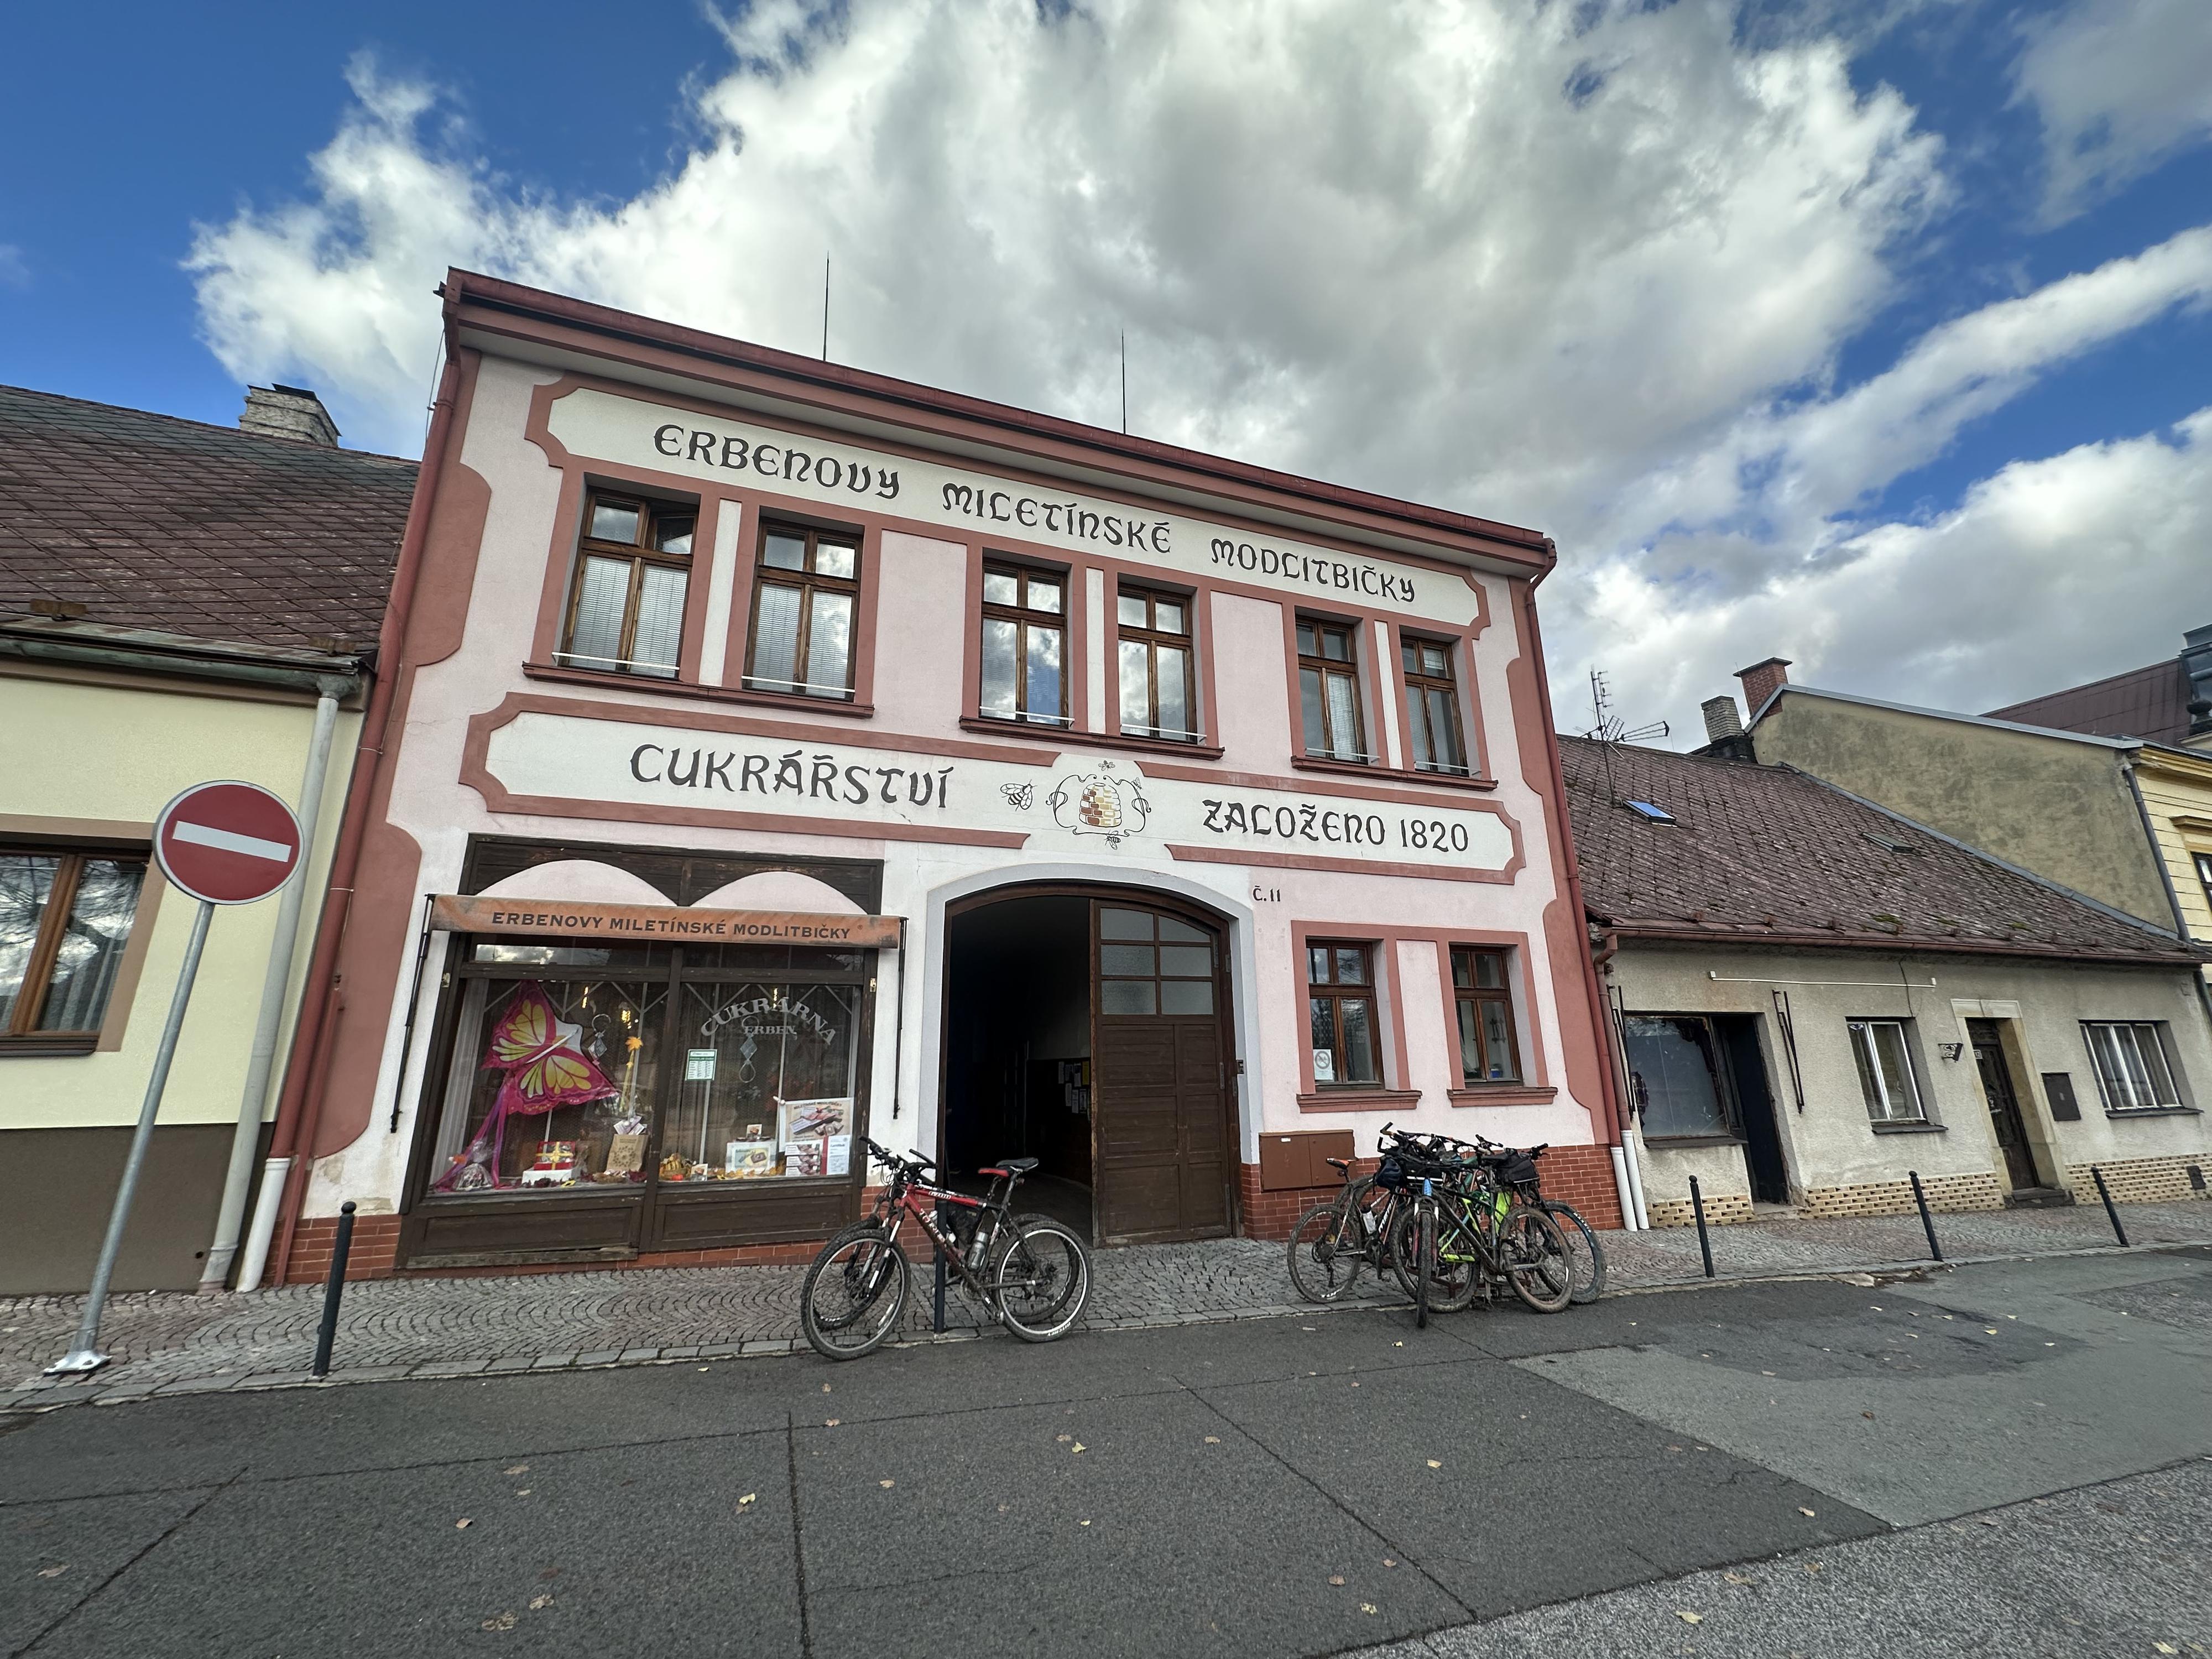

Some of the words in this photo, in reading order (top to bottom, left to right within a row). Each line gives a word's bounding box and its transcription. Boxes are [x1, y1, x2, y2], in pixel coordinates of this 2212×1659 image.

[654, 424, 900, 500] ERBENOVY
[942, 482, 1171, 554] MILETÍNSKÉ
[1211, 538, 1415, 603] MODLITBIČKY
[629, 744, 954, 808] CUKRÁŘSTVÍ
[1202, 799, 1386, 846] ZALOŽENO
[1400, 818, 1469, 853] 1820
[492, 911, 603, 928] ERBENOVY
[609, 916, 726, 935] MILETÍNSKÉ
[733, 923, 851, 939] MODLITBIČKY
[743, 1026, 796, 1035] ERBEN
